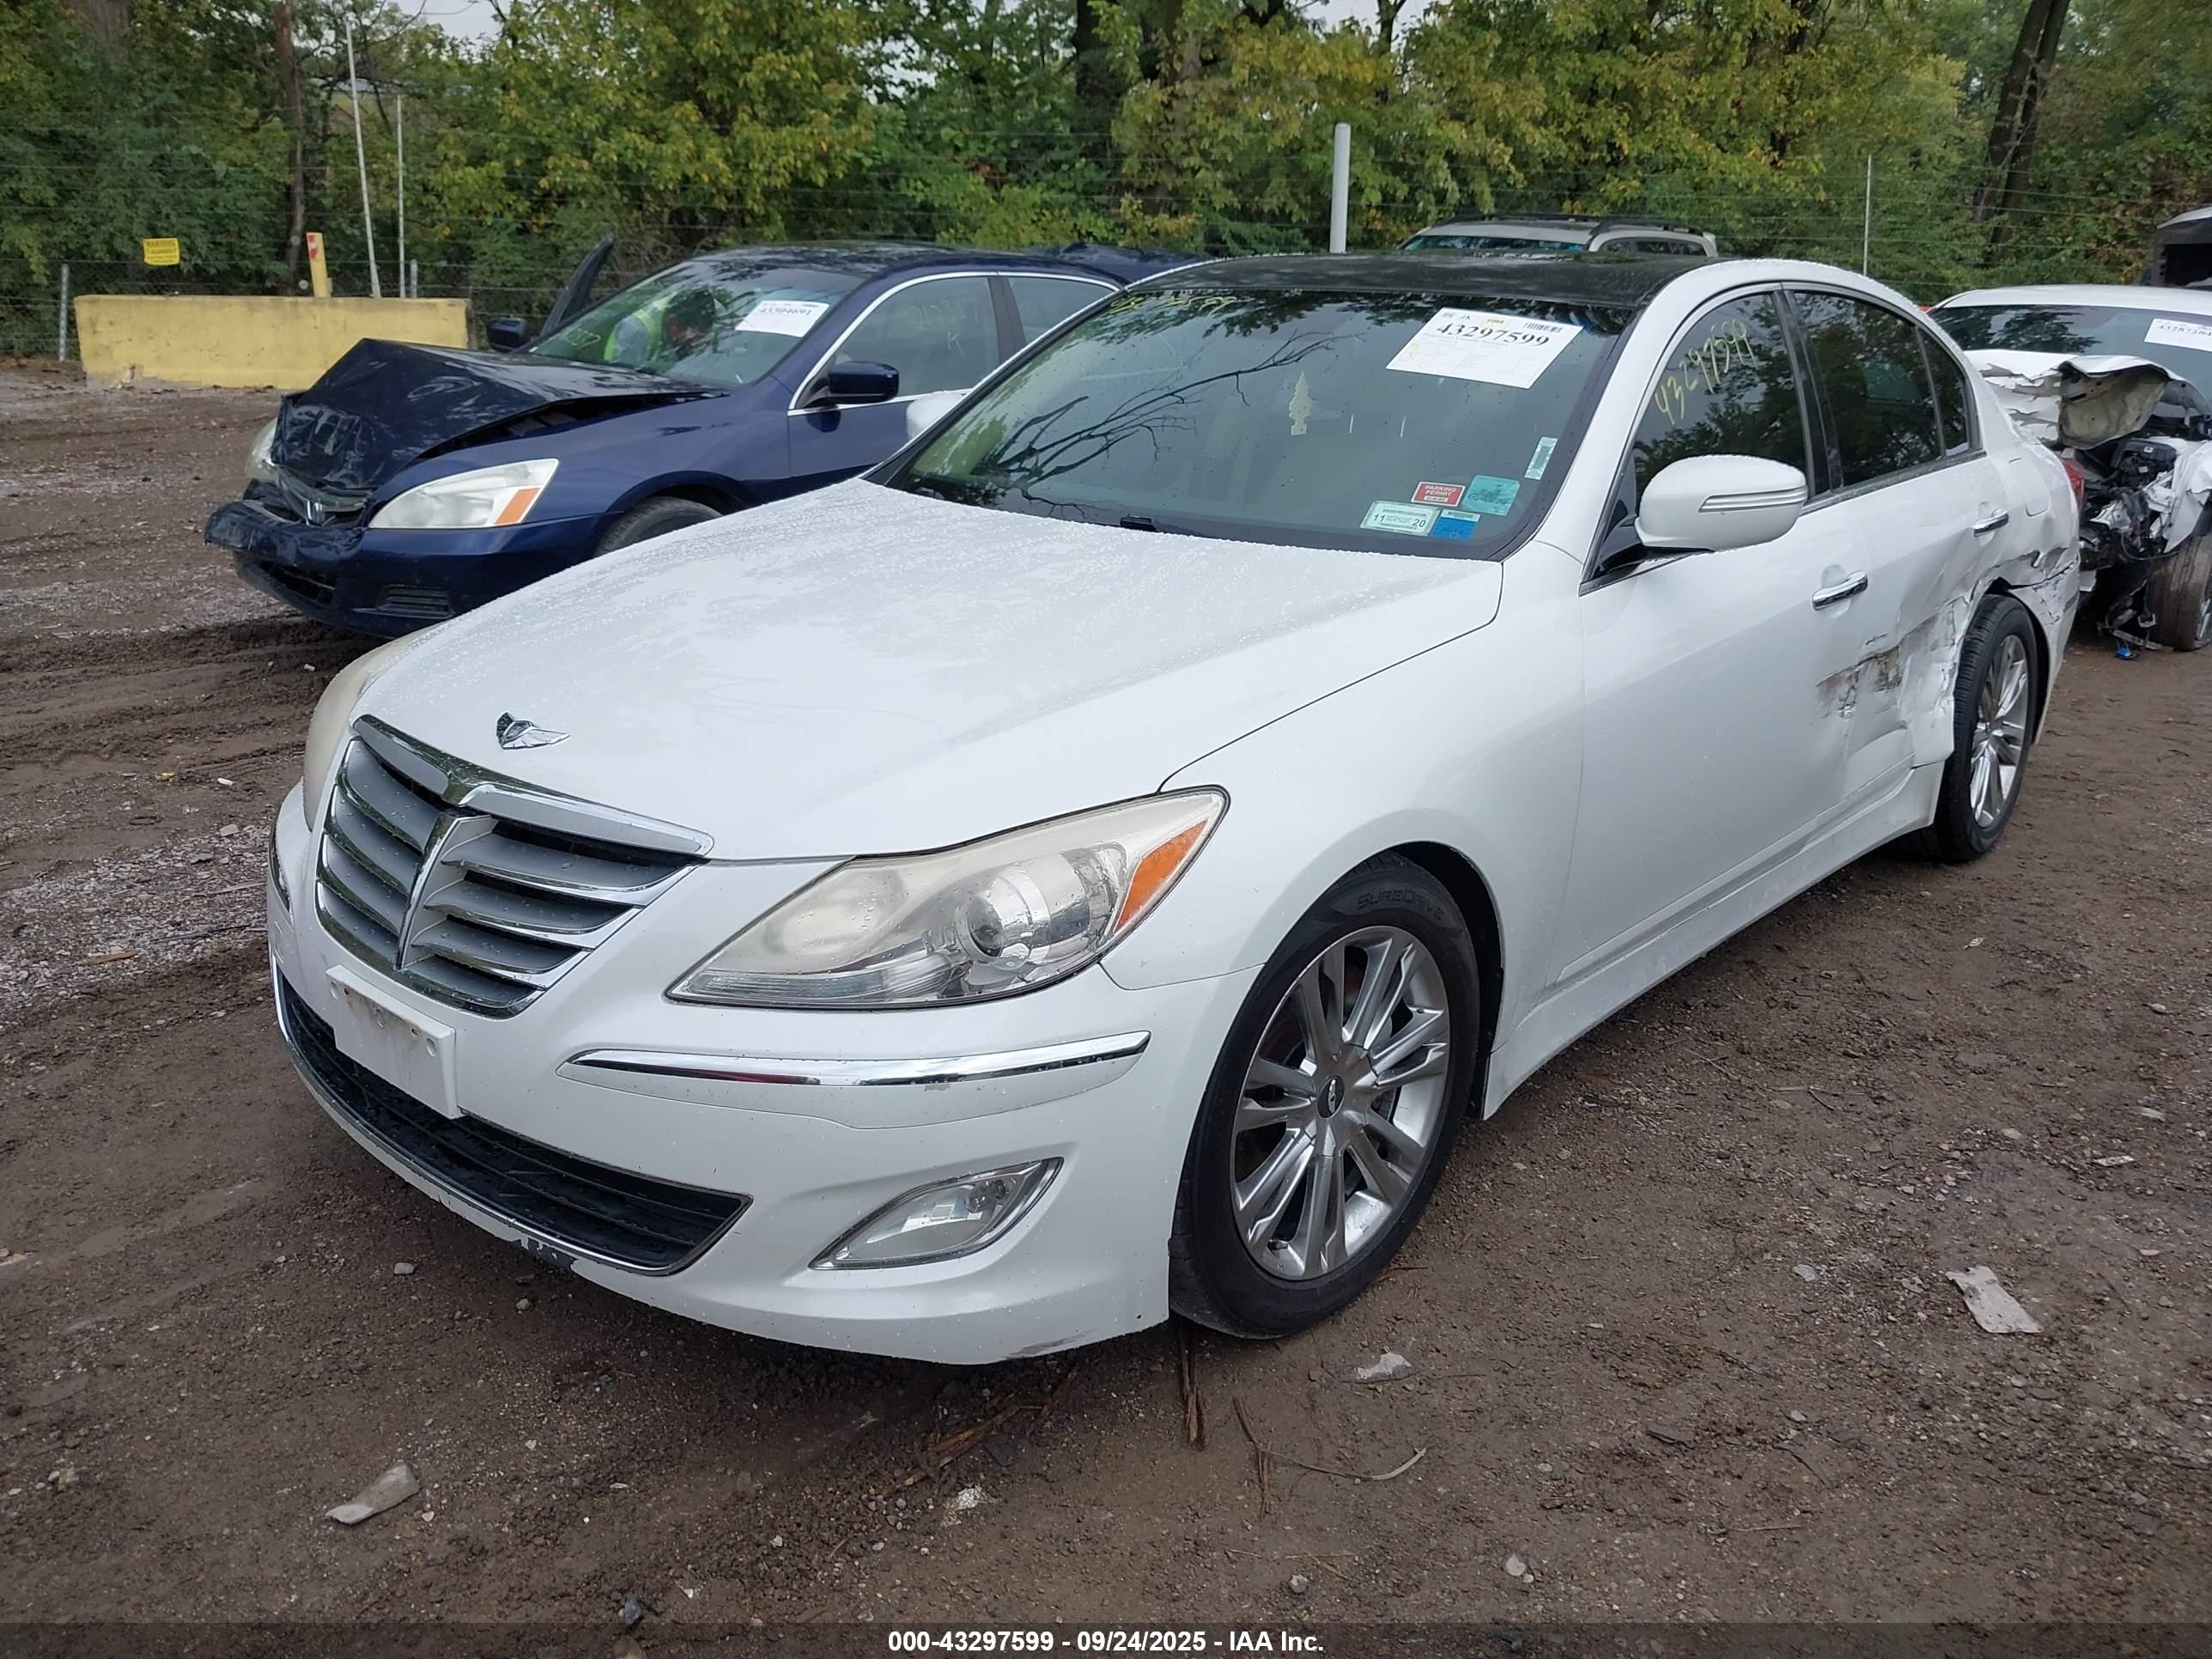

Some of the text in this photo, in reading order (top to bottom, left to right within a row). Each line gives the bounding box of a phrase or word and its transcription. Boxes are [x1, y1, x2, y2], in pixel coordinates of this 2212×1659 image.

[1437, 322, 1550, 347] 43297599
[1374, 514, 1385, 522] 11
[1412, 519, 1426, 528] 20
